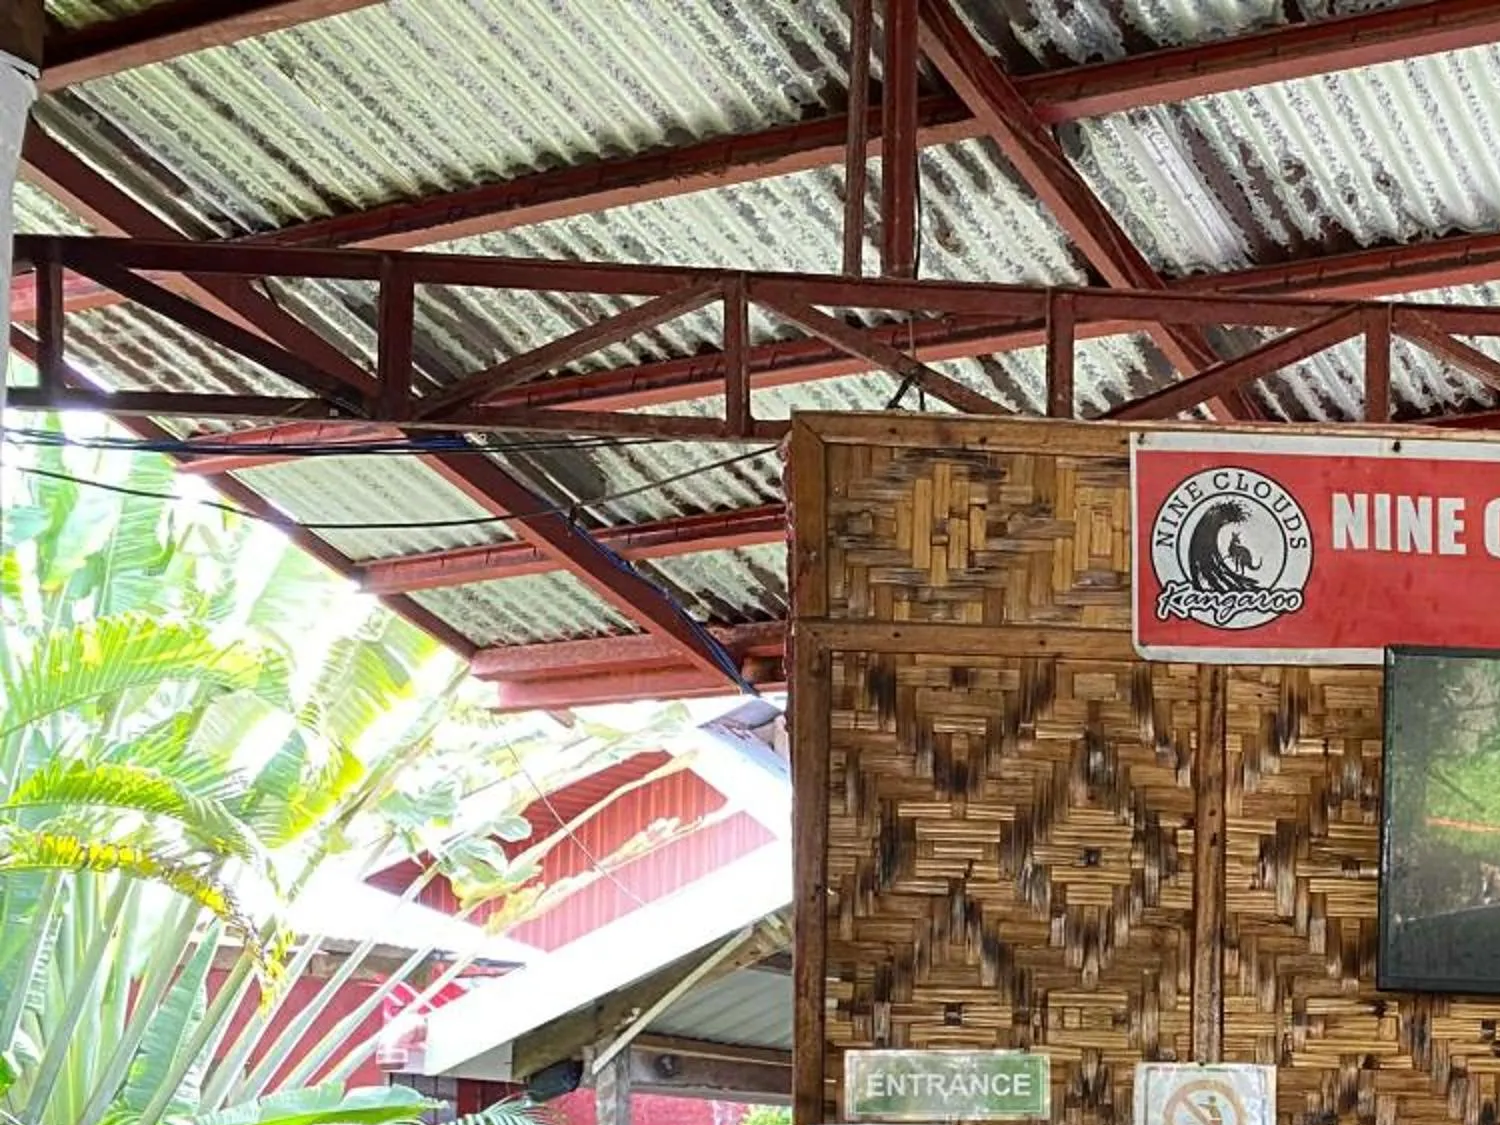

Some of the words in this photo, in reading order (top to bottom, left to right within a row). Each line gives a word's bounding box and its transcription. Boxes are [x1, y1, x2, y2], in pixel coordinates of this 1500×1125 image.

[1155, 481, 1203, 548] NINE
[1213, 471, 1308, 549] CLOUDS
[1331, 492, 1467, 556] NINE
[1160, 584, 1300, 621] Kangaroo
[867, 1072, 1032, 1098] ENTRANCE
